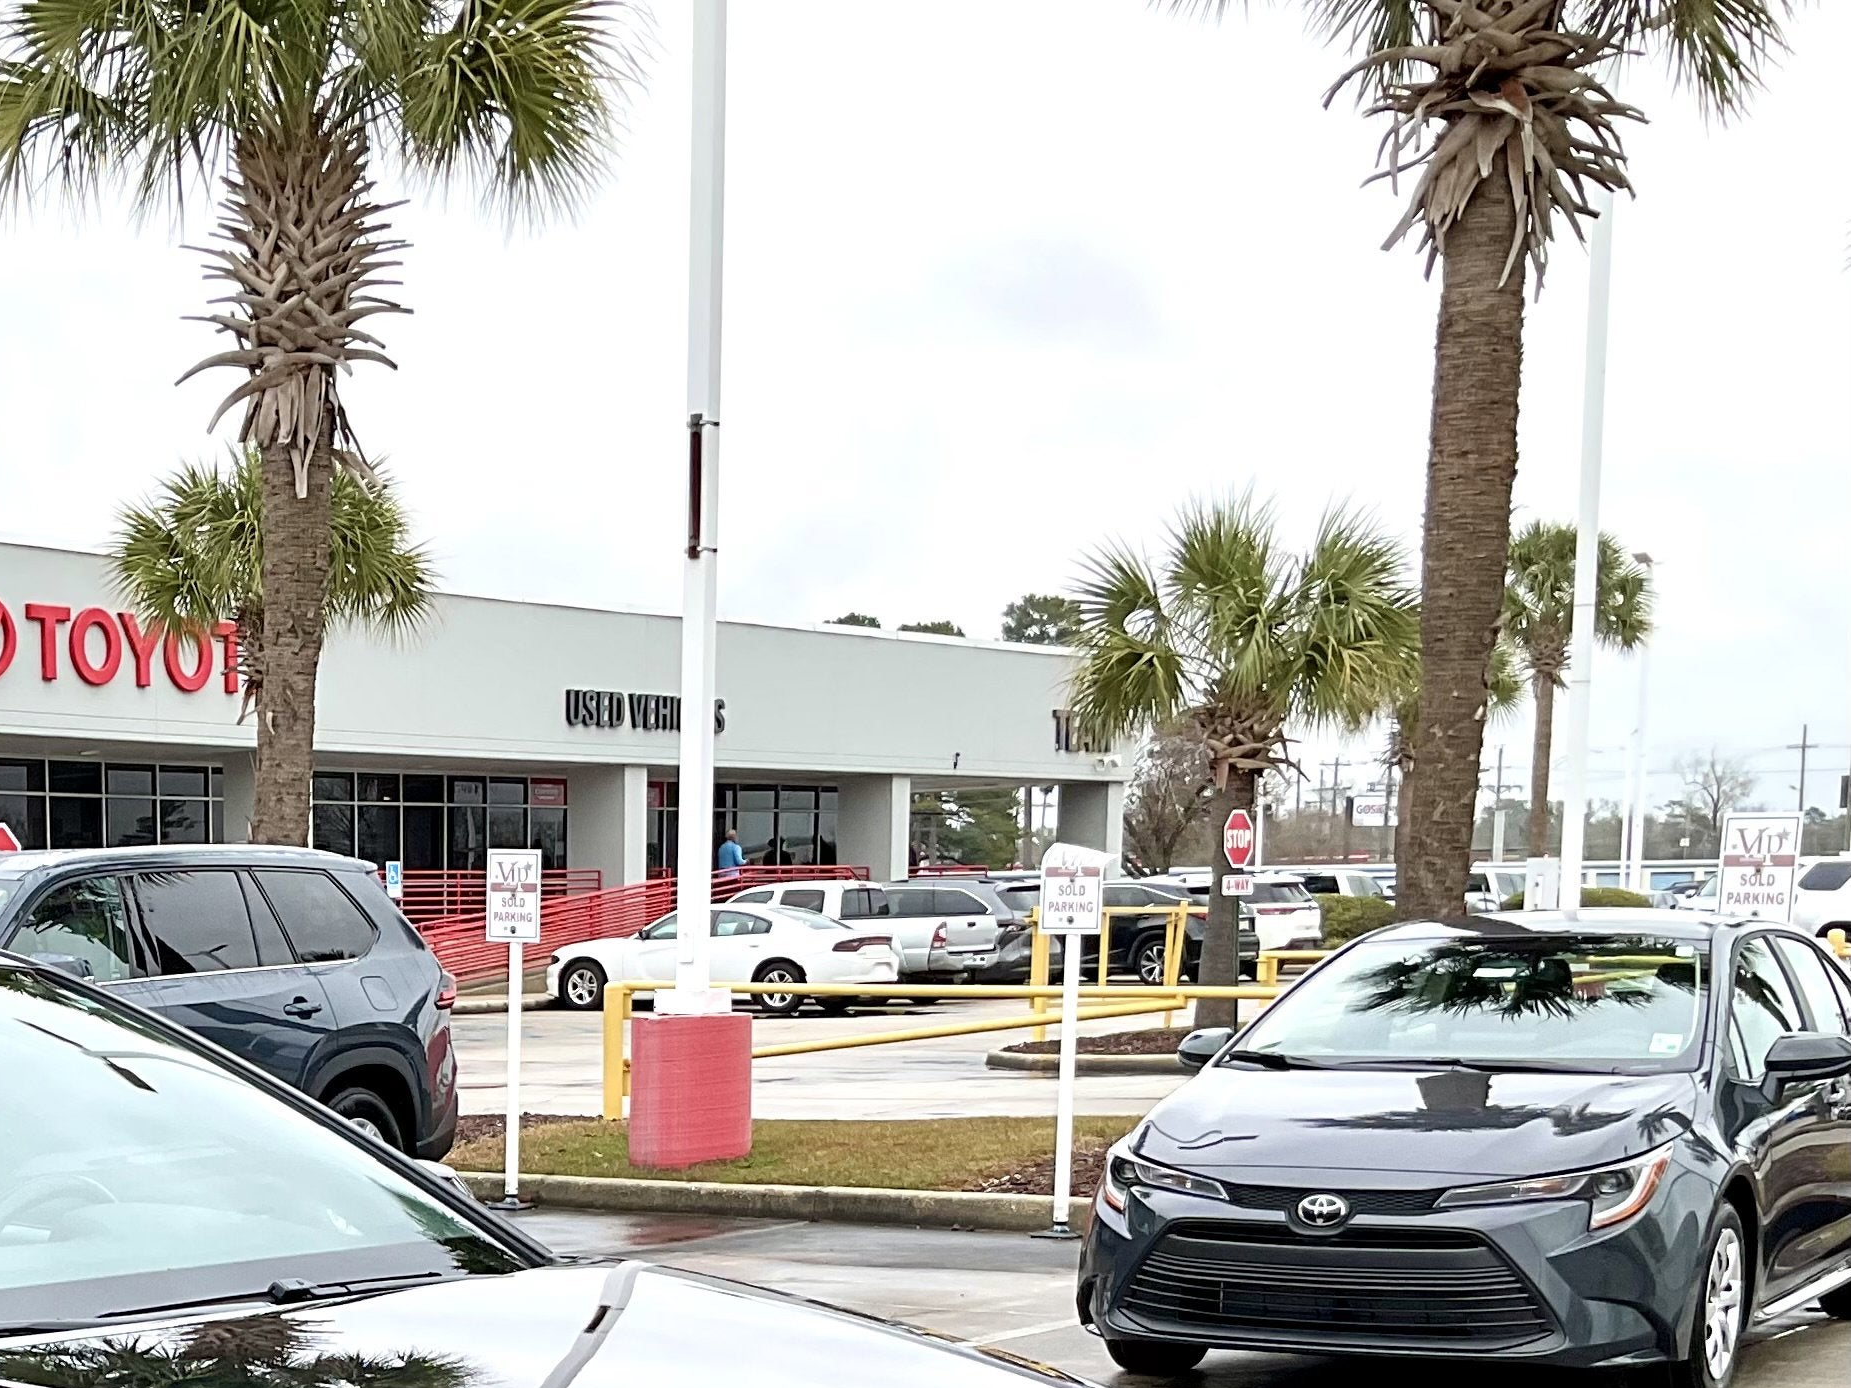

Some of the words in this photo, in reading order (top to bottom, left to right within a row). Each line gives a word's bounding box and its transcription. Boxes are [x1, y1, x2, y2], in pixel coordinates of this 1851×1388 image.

[25, 603, 240, 693] TOYOT
[565, 689, 626, 728] USED
[627, 693, 726, 735] VEHIS
[1226, 829, 1251, 849] STOP
[1226, 879, 1250, 891] 4-WAY
[1739, 873, 1776, 887] SOLD
[1058, 884, 1086, 897] SOLD
[501, 897, 526, 908] SOLD
[1726, 892, 1785, 905] PARKING
[1047, 901, 1094, 913] PARKING
[493, 911, 533, 922] PARKING
